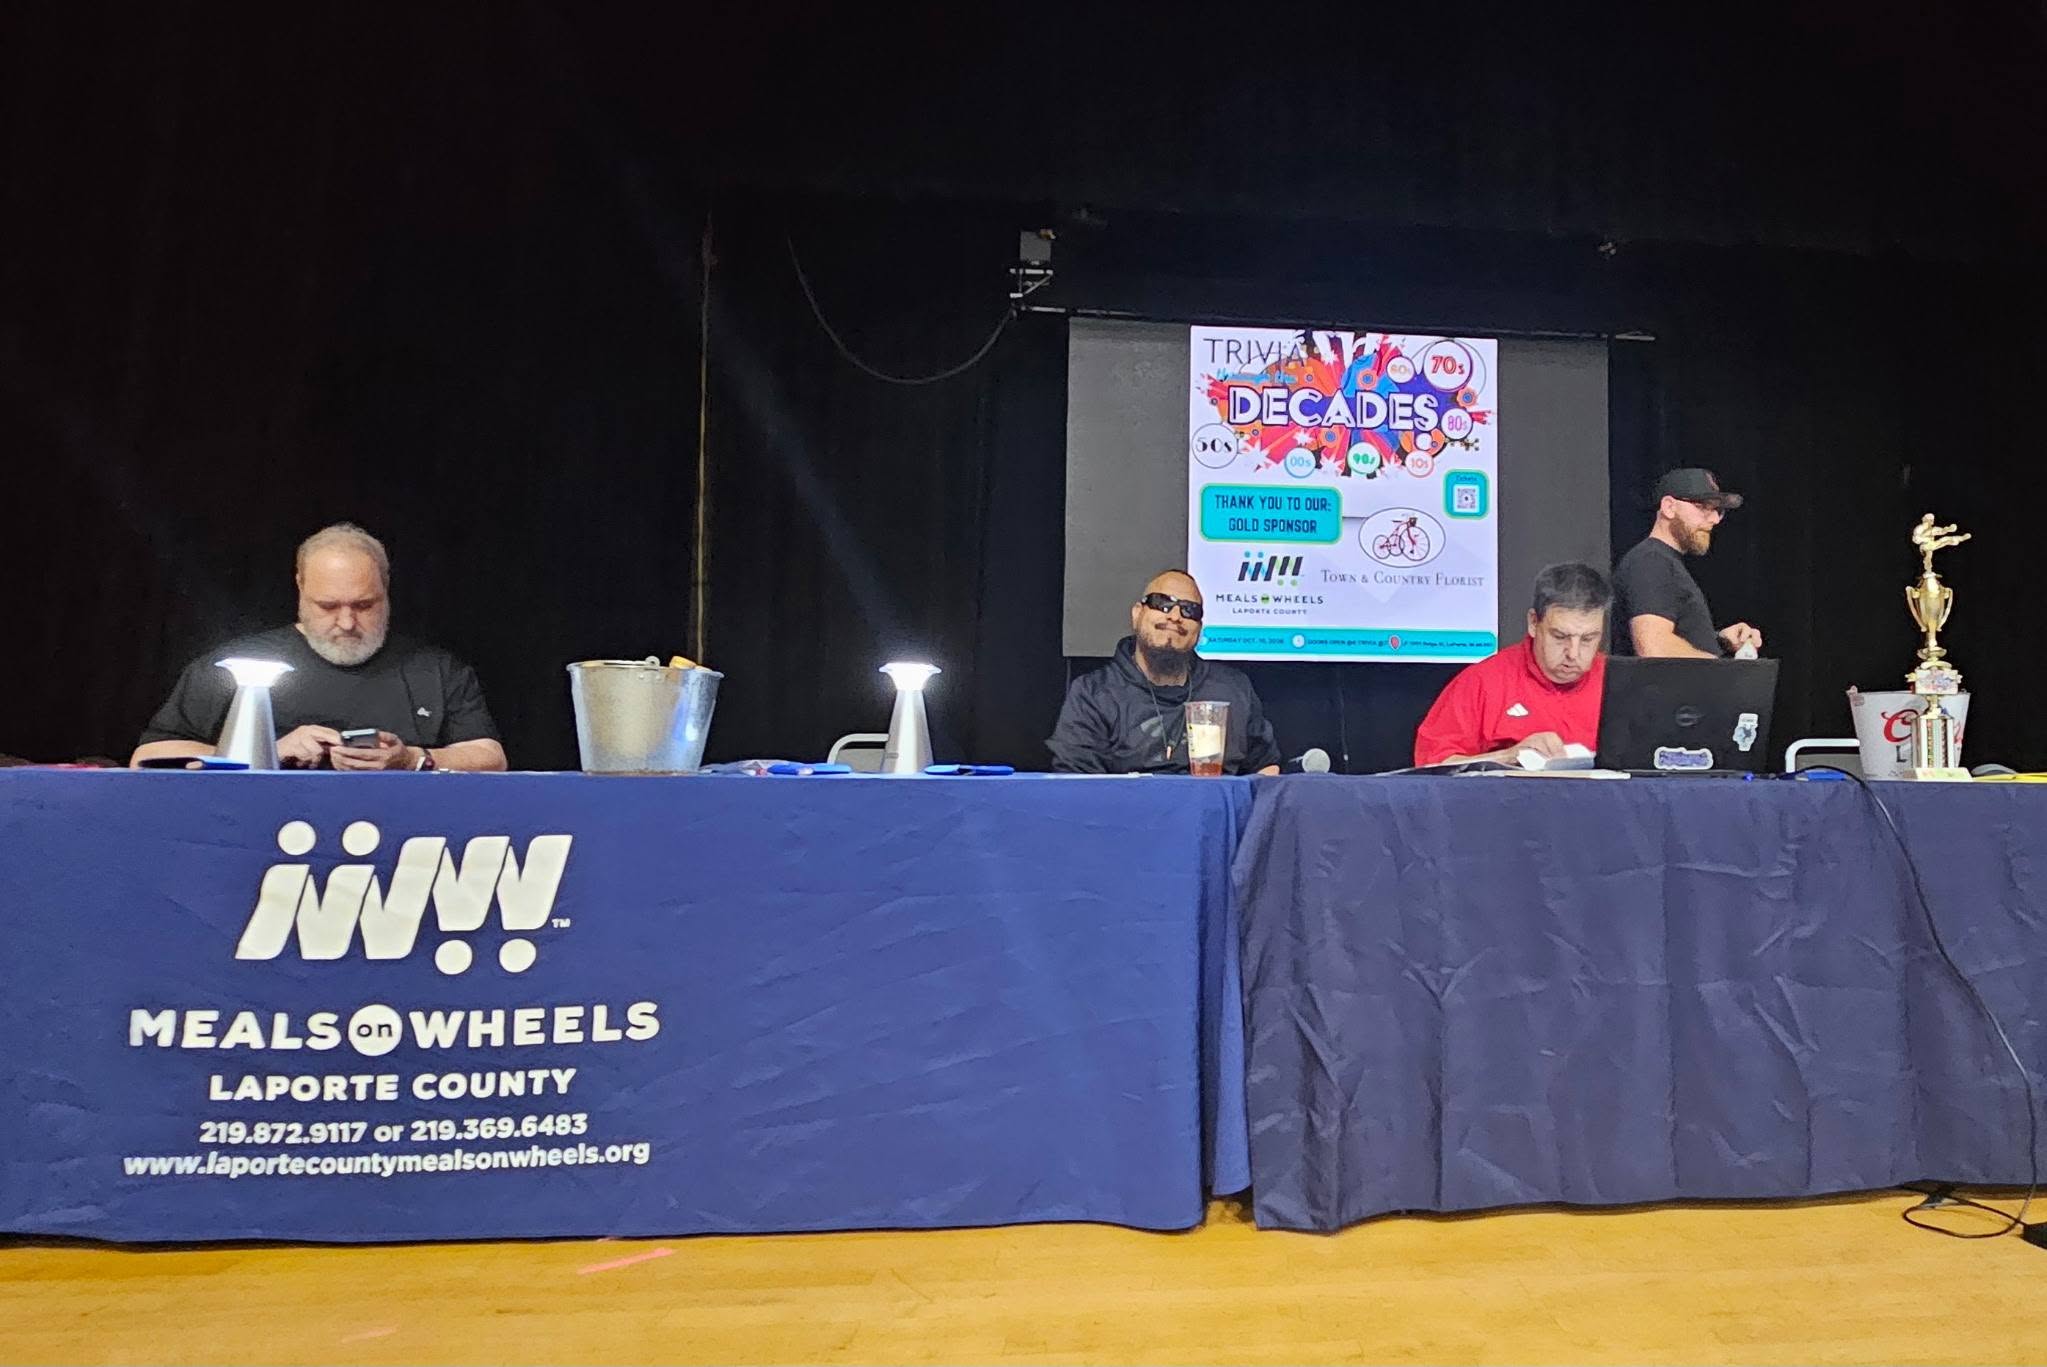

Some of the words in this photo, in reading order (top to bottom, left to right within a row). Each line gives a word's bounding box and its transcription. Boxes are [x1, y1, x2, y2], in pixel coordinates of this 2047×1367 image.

[1203, 338, 1304, 367] TRIVIA
[1431, 355, 1465, 375] 70s
[1227, 385, 1439, 432] DECADES
[1447, 415, 1468, 431] 80s
[1196, 437, 1232, 454] 50s
[1215, 494, 1254, 510] THANK
[1259, 496, 1282, 511] YOU
[1286, 496, 1301, 511] TO
[1304, 497, 1332, 512] OUR:
[1228, 517, 1259, 532] GOLD
[1263, 518, 1317, 534] SPONSOR
[1215, 593, 1258, 604] MEALS
[1272, 595, 1324, 605] WHEELS
[129, 1008, 339, 1050] MEALS
[356, 1021, 393, 1038] on
[409, 1001, 661, 1048] WHEELS
[209, 1074, 399, 1101] LAPORTE
[412, 1067, 577, 1098] COUNTY
[199, 1121, 368, 1144] 219.872.9117
[373, 1124, 403, 1141] or
[410, 1113, 589, 1141] 219.369.6483
[123, 1142, 651, 1179] www.laportecountymealsonwheels.org
